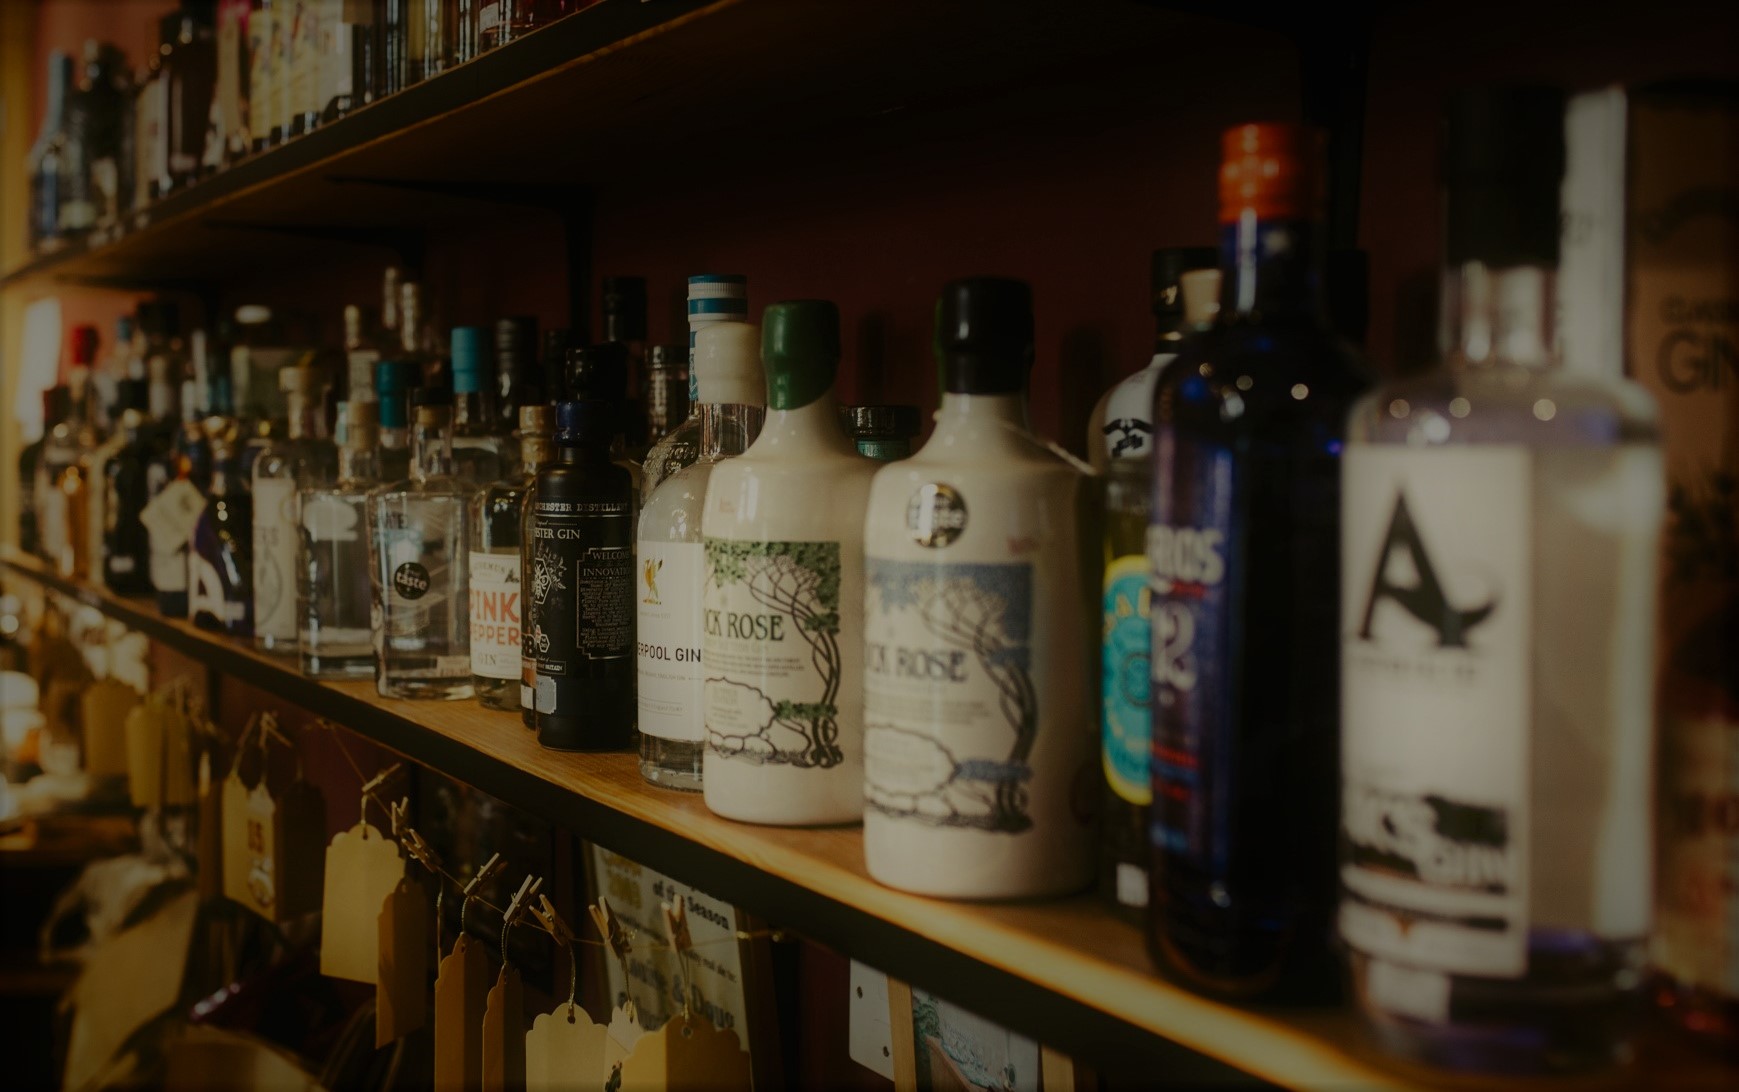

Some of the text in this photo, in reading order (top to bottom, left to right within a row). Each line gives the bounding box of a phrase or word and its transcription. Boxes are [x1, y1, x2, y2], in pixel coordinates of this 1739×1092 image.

[557, 528, 581, 540] GIN
[396, 571, 428, 592] taste
[727, 612, 785, 641] ROSE
[675, 647, 701, 663] GIN
[687, 895, 730, 931] Season
